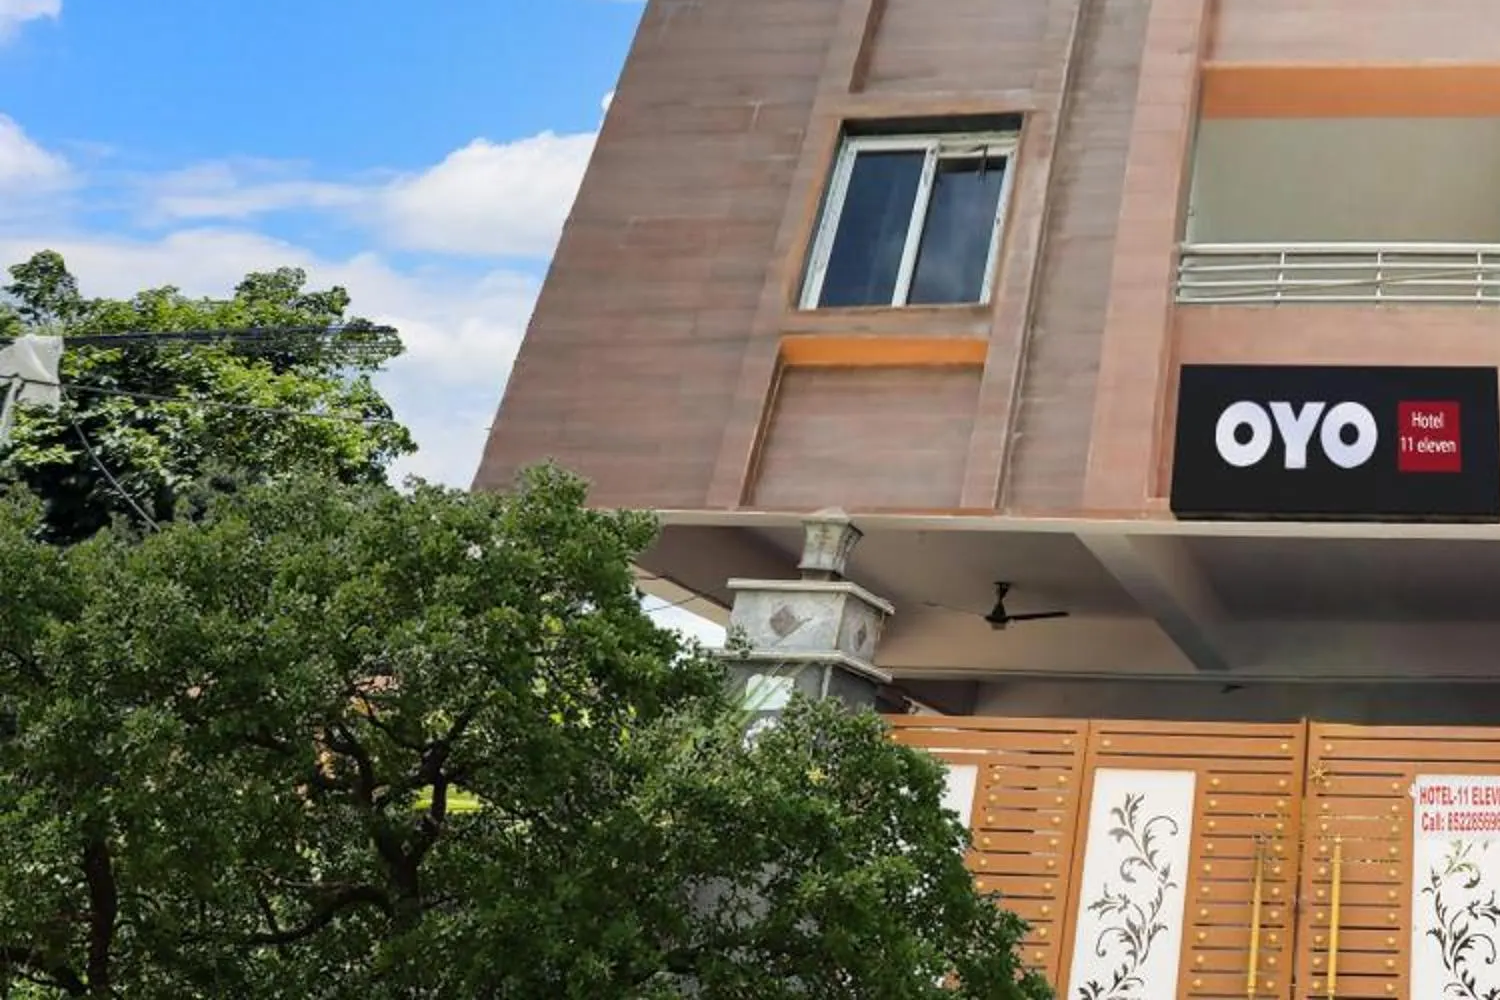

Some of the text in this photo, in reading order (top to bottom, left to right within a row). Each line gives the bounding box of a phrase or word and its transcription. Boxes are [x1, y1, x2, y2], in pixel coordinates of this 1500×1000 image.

[1411, 410, 1444, 430] Hotel
[1215, 400, 1378, 469] OYO
[1400, 437, 1456, 454] 11 eleven
[1421, 812, 1445, 832] Call:
